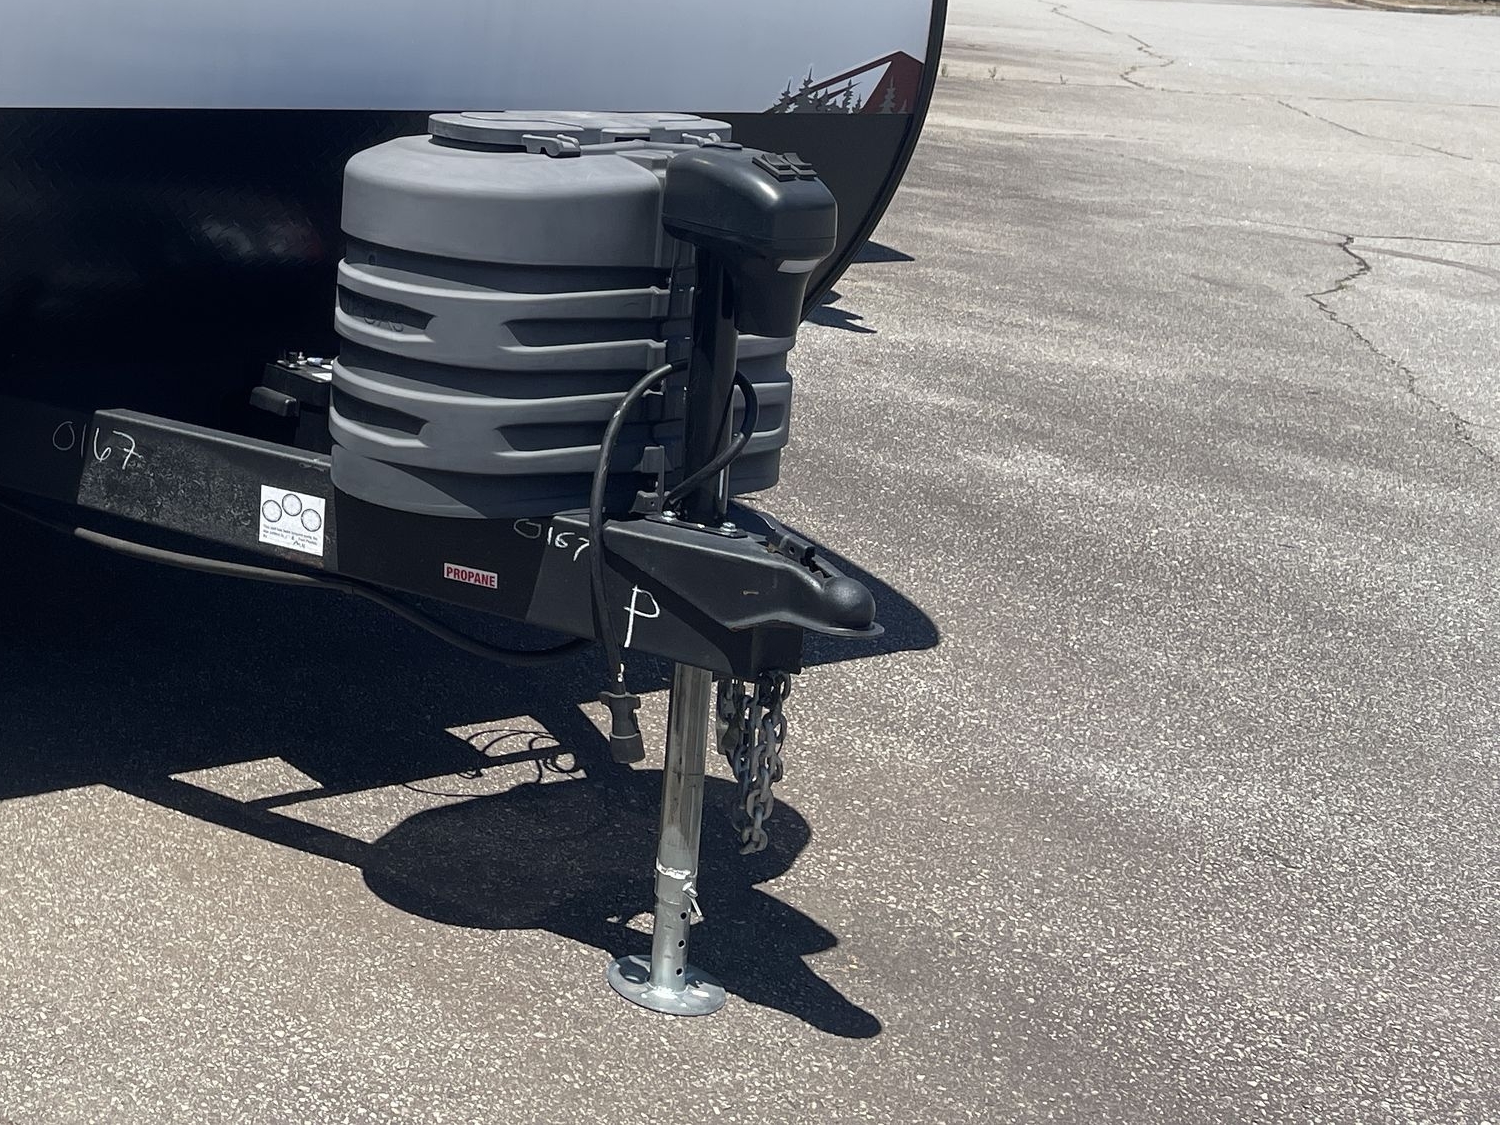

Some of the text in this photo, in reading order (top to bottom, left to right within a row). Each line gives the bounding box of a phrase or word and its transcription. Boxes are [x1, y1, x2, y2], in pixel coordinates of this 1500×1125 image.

[52, 421, 143, 470] 0167
[446, 566, 496, 587] PROPANE
[623, 585, 661, 648] P
